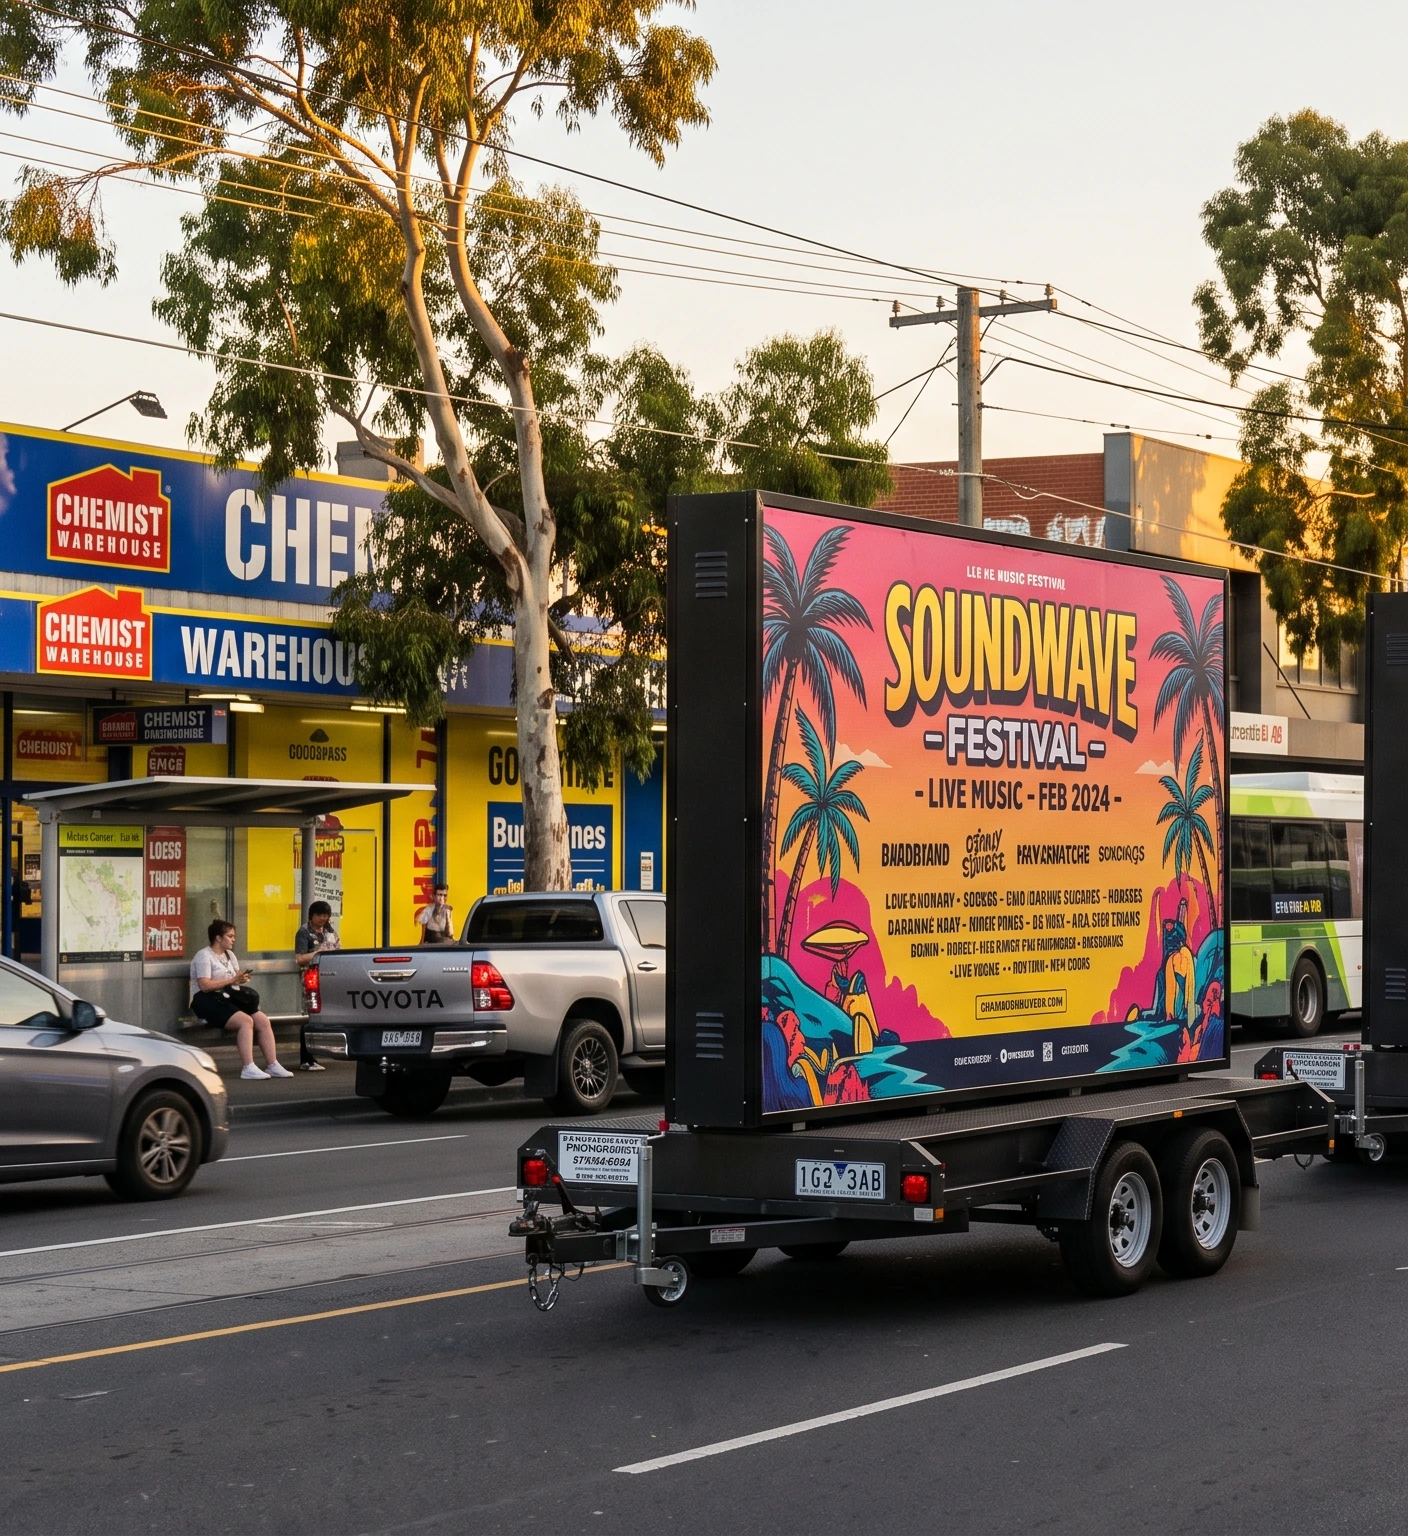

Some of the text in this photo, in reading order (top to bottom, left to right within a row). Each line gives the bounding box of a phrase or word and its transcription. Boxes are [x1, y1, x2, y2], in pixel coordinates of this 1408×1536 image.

[57, 493, 163, 536] CHEMIST
[57, 530, 161, 559] WAREHOUSE
[1027, 573, 1066, 590] FESTIVAL
[45, 612, 145, 649] CHEMIST
[46, 646, 143, 669] WAREHOUSE
[884, 582, 1138, 734] SOUNDWAVE
[144, 711, 206, 727] CHEMIST
[947, 716, 1087, 767] FESTIVAL
[929, 778, 966, 808] LIVE
[971, 780, 1023, 810] MUSIC
[1039, 782, 1067, 811] FEB
[1071, 784, 1110, 812] 2024
[150, 841, 181, 860] LOESS
[347, 989, 444, 1010] TOYOTA
[801, 1166, 881, 1191] 1G2 3AB
